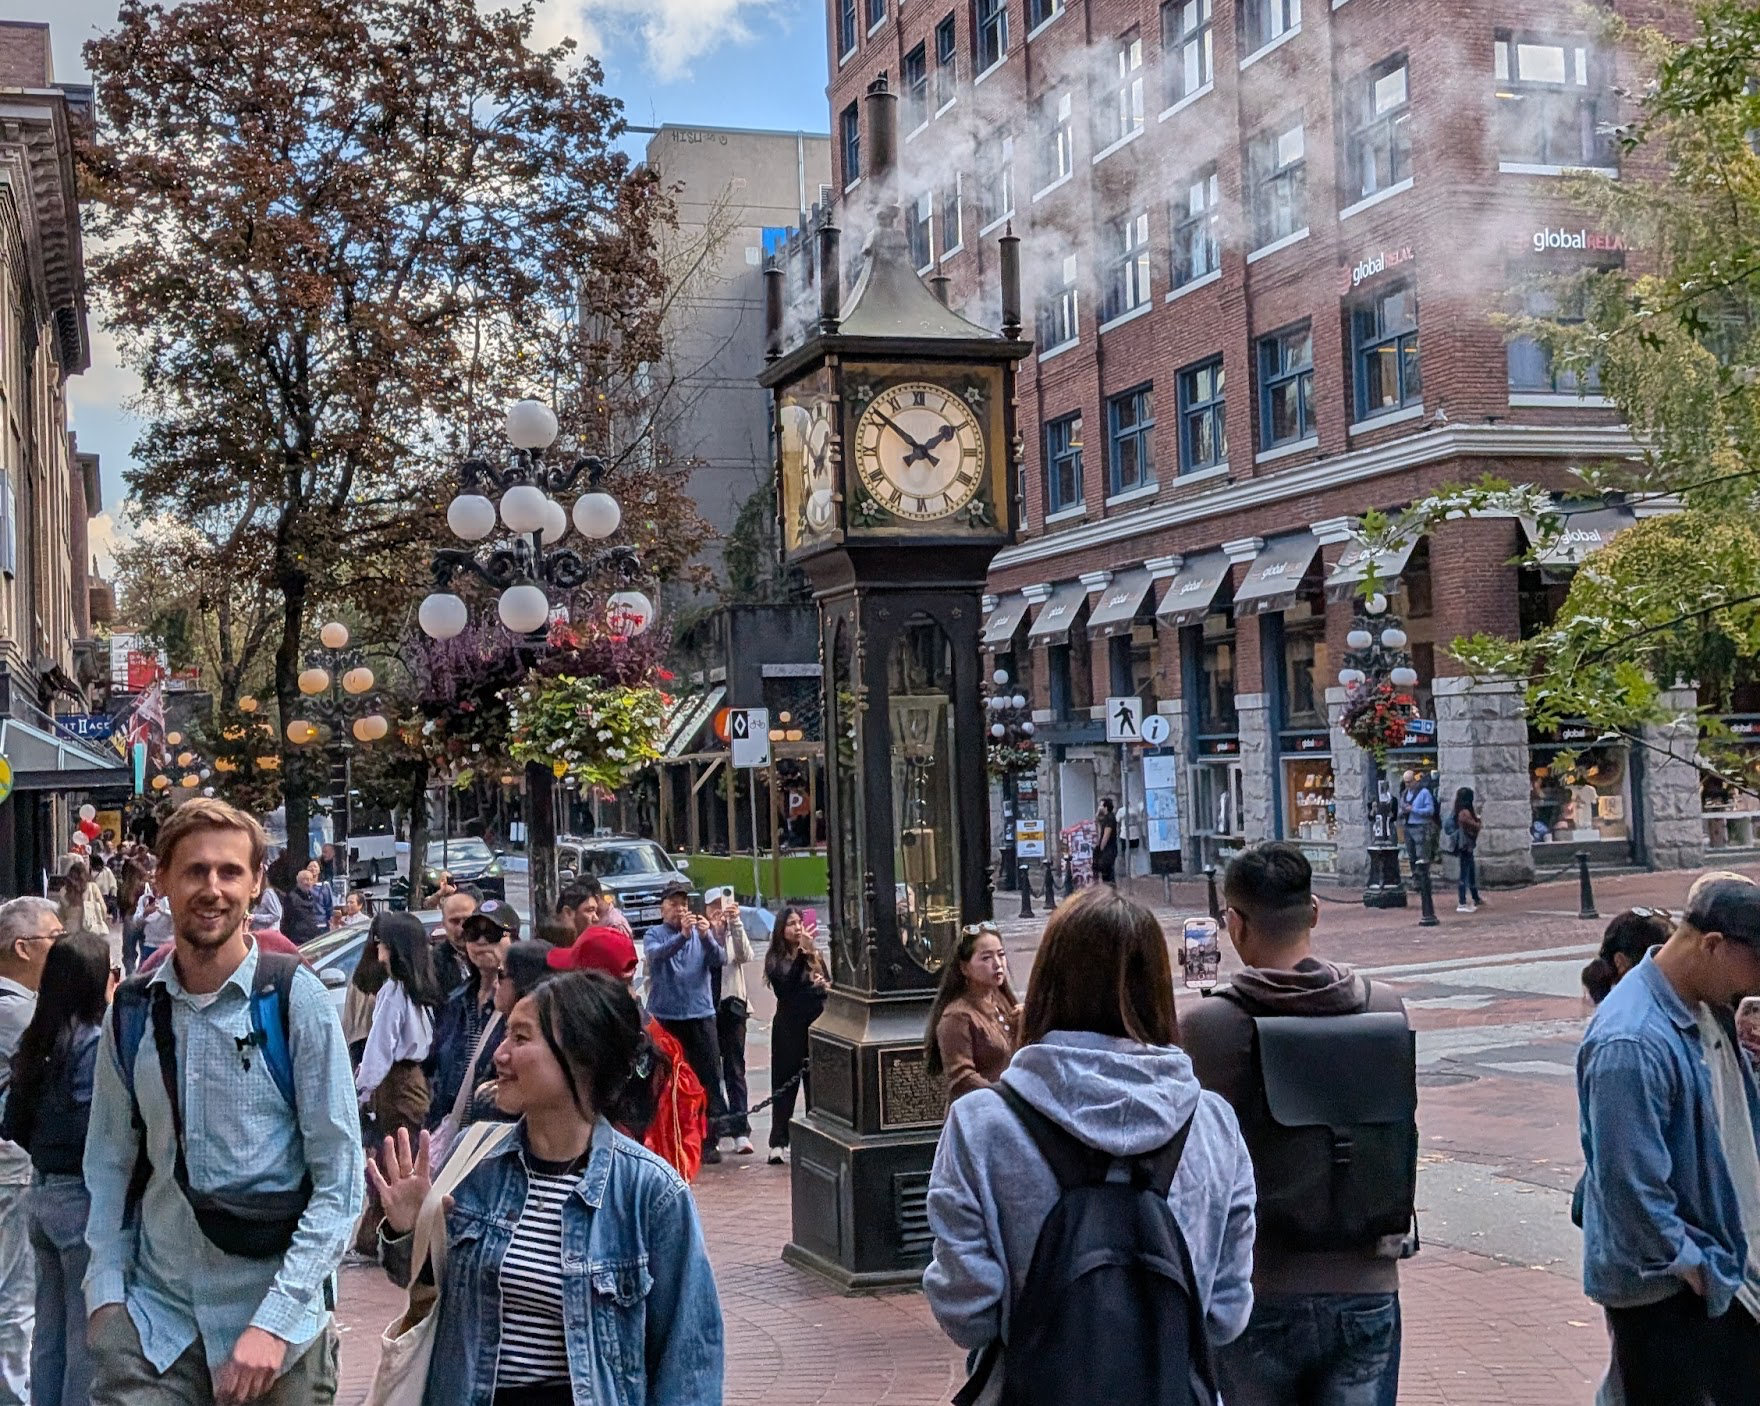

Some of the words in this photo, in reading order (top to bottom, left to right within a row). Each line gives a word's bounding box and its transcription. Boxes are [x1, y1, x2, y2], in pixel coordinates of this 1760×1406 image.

[1533, 227, 1586, 251] global
[1353, 252, 1384, 286] global
[1559, 528, 1602, 545] global
